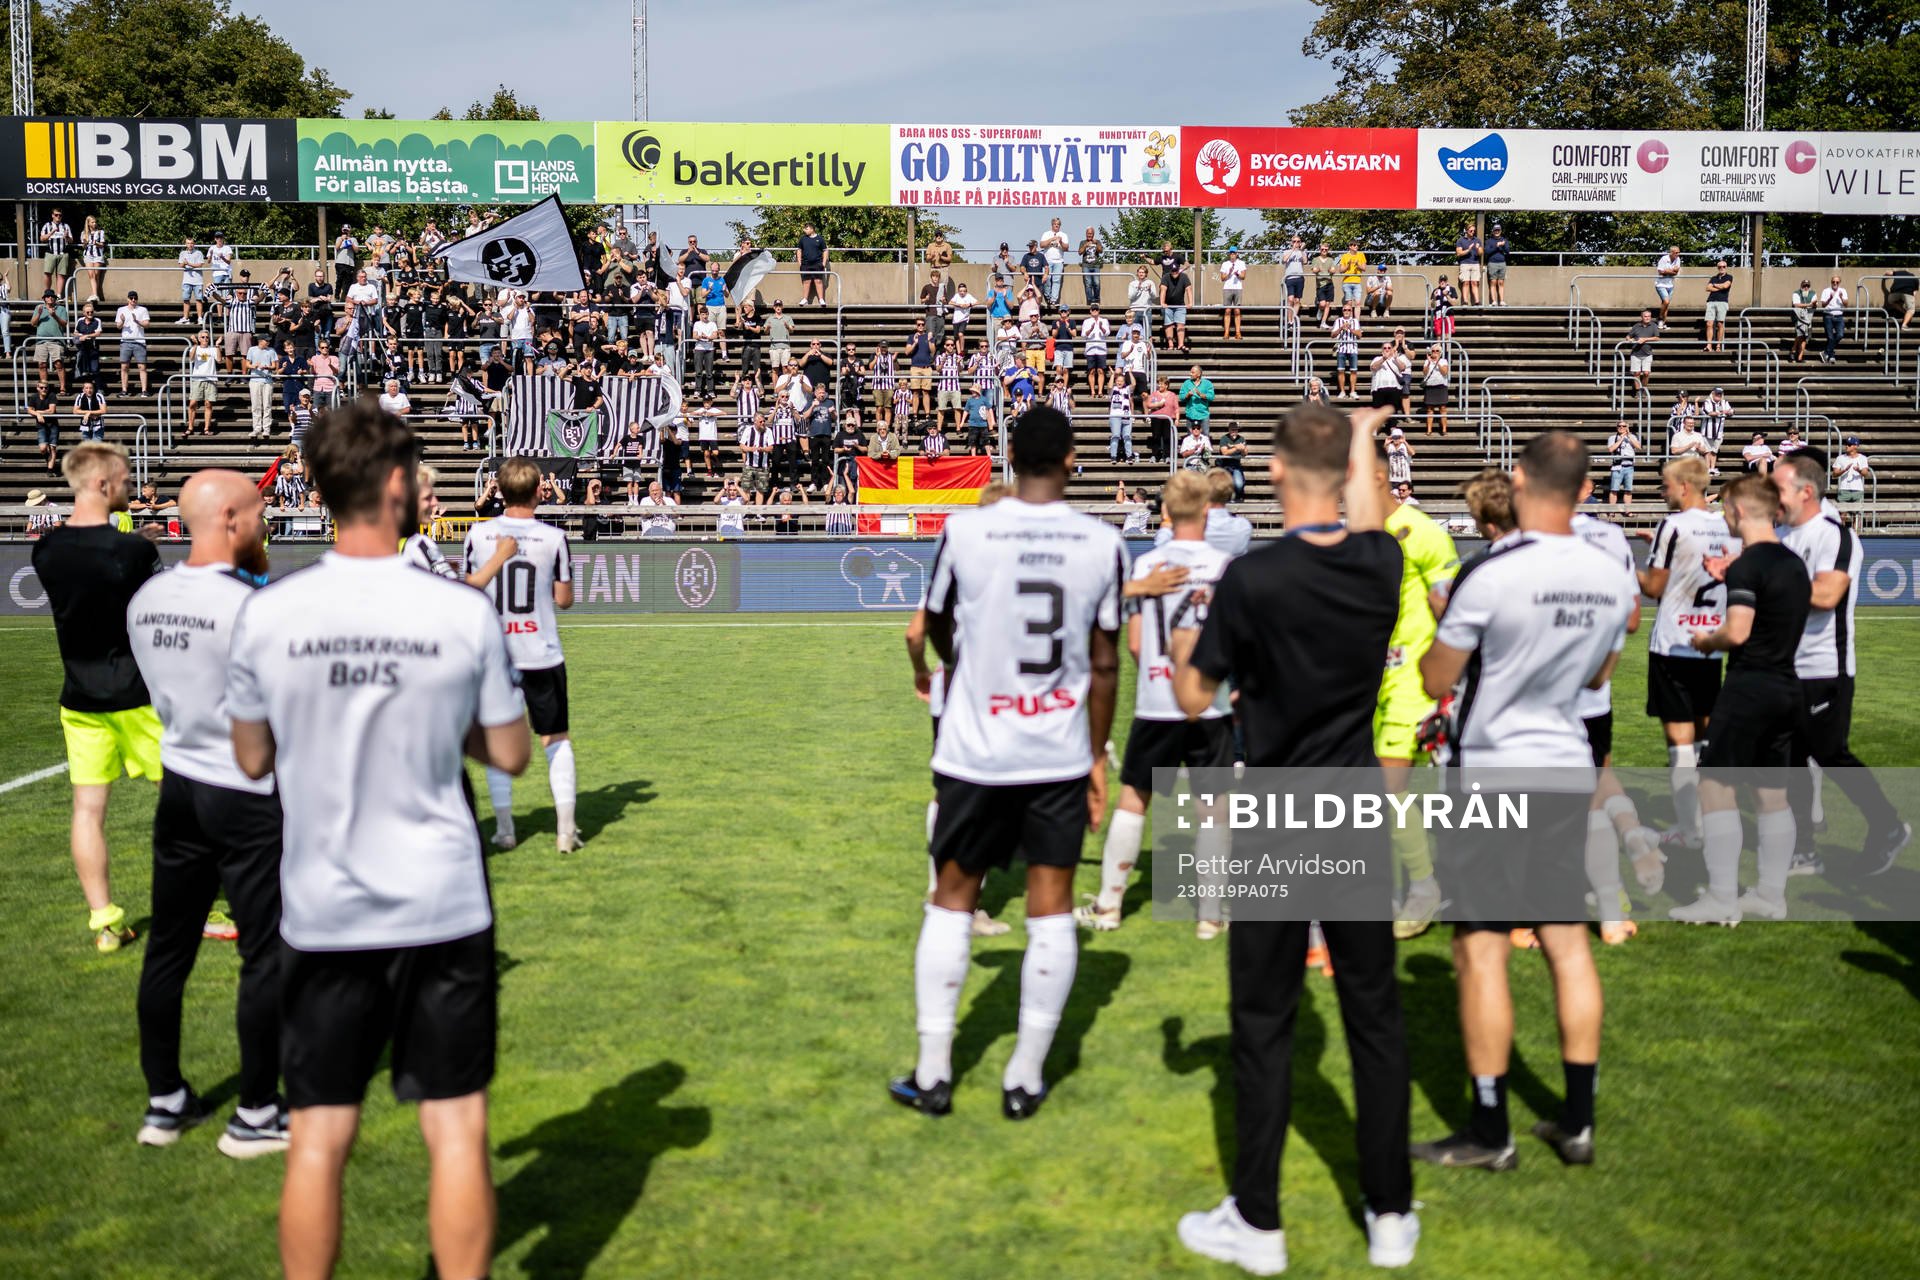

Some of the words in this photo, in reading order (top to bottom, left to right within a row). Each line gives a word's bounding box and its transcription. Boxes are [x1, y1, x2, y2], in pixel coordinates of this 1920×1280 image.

[900, 127, 926, 139] BARA
[929, 128, 949, 139] HOS
[951, 128, 970, 139] OSS
[980, 128, 1042, 140] SUPERFOAM!
[1099, 130, 1147, 140] HUNDTVÄTT
[77, 122, 268, 180] BBM
[1553, 145, 1631, 167] COMFORT
[1701, 146, 1779, 168] COMFORT
[314, 155, 388, 172] Allmän
[394, 157, 453, 176] nytta.
[531, 161, 575, 171] LANDS
[901, 142, 950, 183] GO
[962, 137, 1127, 183] BILTVÄTT
[532, 172, 579, 183] KRONA
[674, 150, 866, 197] bakertilly
[1250, 175, 1254, 186] I
[1257, 173, 1301, 187] SKÅNE
[1552, 172, 1608, 184] CARL-PHILIPS
[1610, 173, 1628, 184] VVS
[1701, 173, 1756, 185] CARL-PHILIPS
[1758, 174, 1776, 185] VVS
[1826, 169, 1916, 195] WILE
[26, 182, 121, 195] BORSTAHUSENS
[125, 183, 163, 195] BYGG
[167, 184, 177, 195] &
[180, 184, 246, 196] MONTAGE
[250, 185, 268, 196] AB
[315, 176, 348, 193] För
[353, 176, 400, 193] allas
[532, 183, 561, 194] HEM
[900, 190, 919, 205] NU
[924, 187, 961, 205] BÅDE
[966, 187, 982, 205] PÅ
[987, 189, 1066, 206] PJÄSGATAN
[1072, 193, 1082, 206] &
[1087, 191, 1178, 207] PUMPGATAN!
[1552, 187, 1616, 202] CENTRALVÄRME
[1700, 188, 1765, 203] CENTRALVÄRME
[136, 613, 215, 631] LANDSKRONA
[1017, 580, 1064, 675] 3
[1678, 614, 1721, 627] PULS
[288, 638, 442, 659] LANDSKRONA
[990, 688, 1076, 716] PULS
